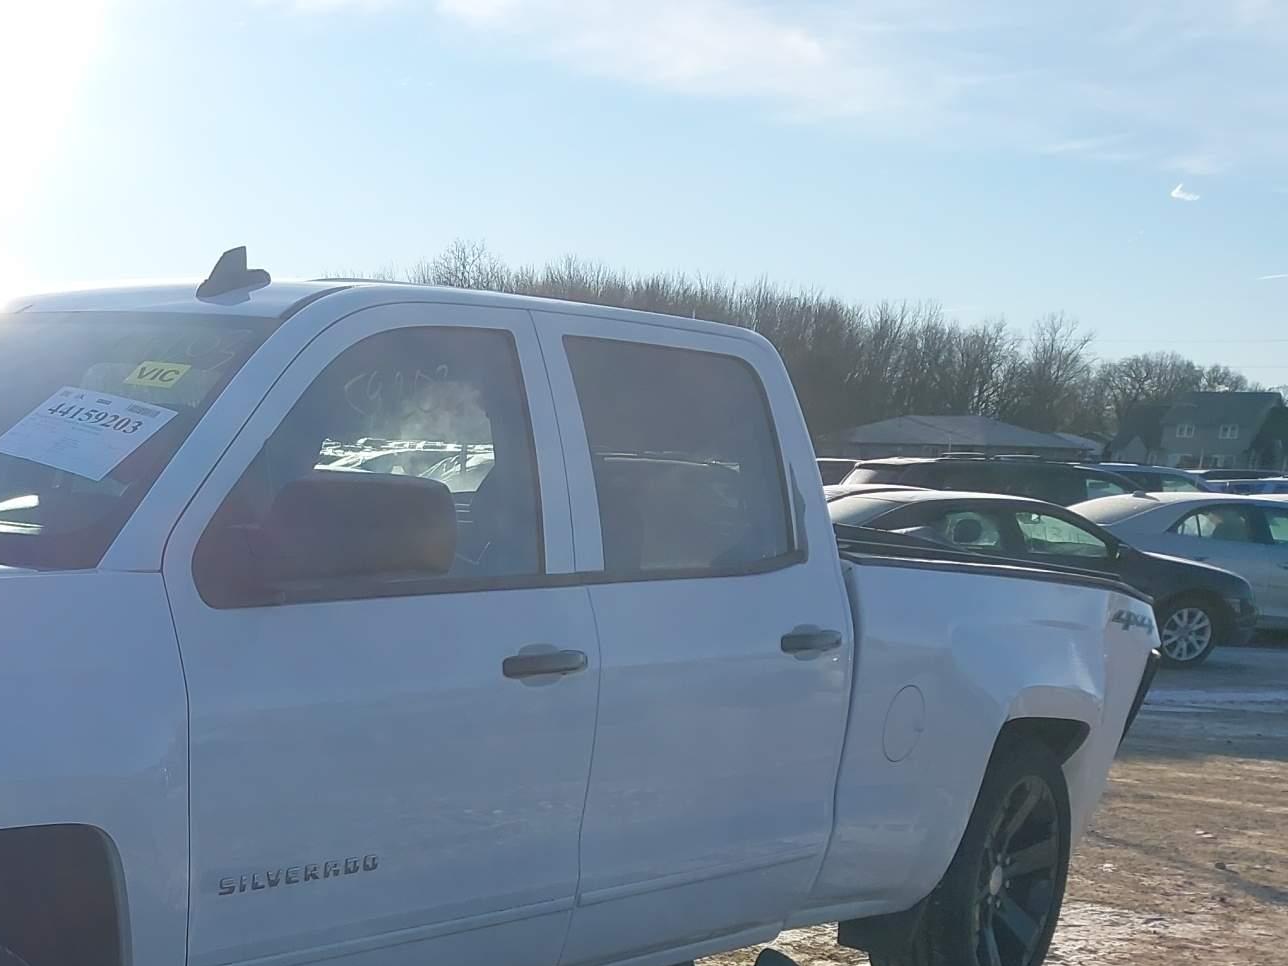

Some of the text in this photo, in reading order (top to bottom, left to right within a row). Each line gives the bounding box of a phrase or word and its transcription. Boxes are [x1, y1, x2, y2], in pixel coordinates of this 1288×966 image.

[136, 366, 180, 382] VIC
[47, 401, 144, 434] 44159203
[218, 854, 379, 896] SILVERADO
